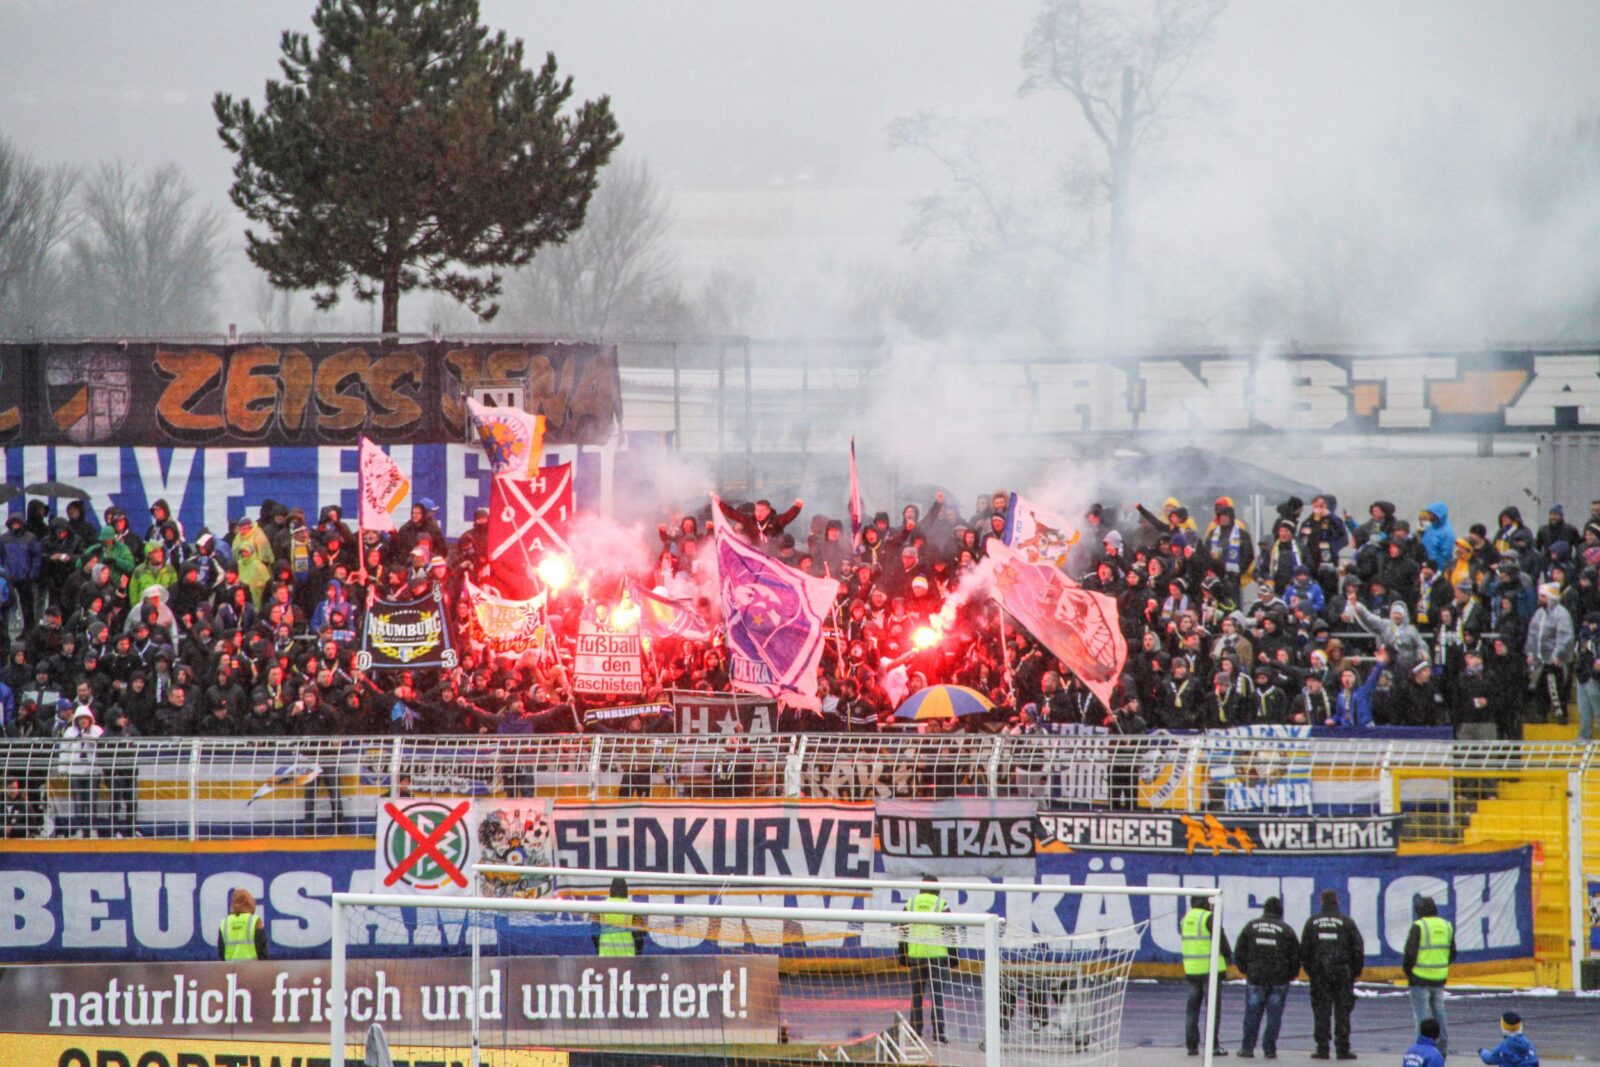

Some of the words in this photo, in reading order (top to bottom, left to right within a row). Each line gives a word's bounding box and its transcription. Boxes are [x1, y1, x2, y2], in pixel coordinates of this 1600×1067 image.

[153, 349, 422, 440] ZEISS
[936, 357, 1456, 433] RNST
[368, 610, 441, 637] NAUMBURG
[441, 649, 457, 668] 3
[580, 635, 637, 654] fußball
[602, 656, 631, 672] den
[574, 675, 641, 692] faschisten
[554, 812, 873, 878] SÜDKURVE
[880, 818, 1034, 857] ULTRAS
[1042, 819, 1174, 848] REFUGEES
[1258, 821, 1394, 849] WELCOME
[49, 973, 253, 1027] natürlich
[420, 969, 503, 1021] und
[521, 967, 748, 1019] unfiltriert!
